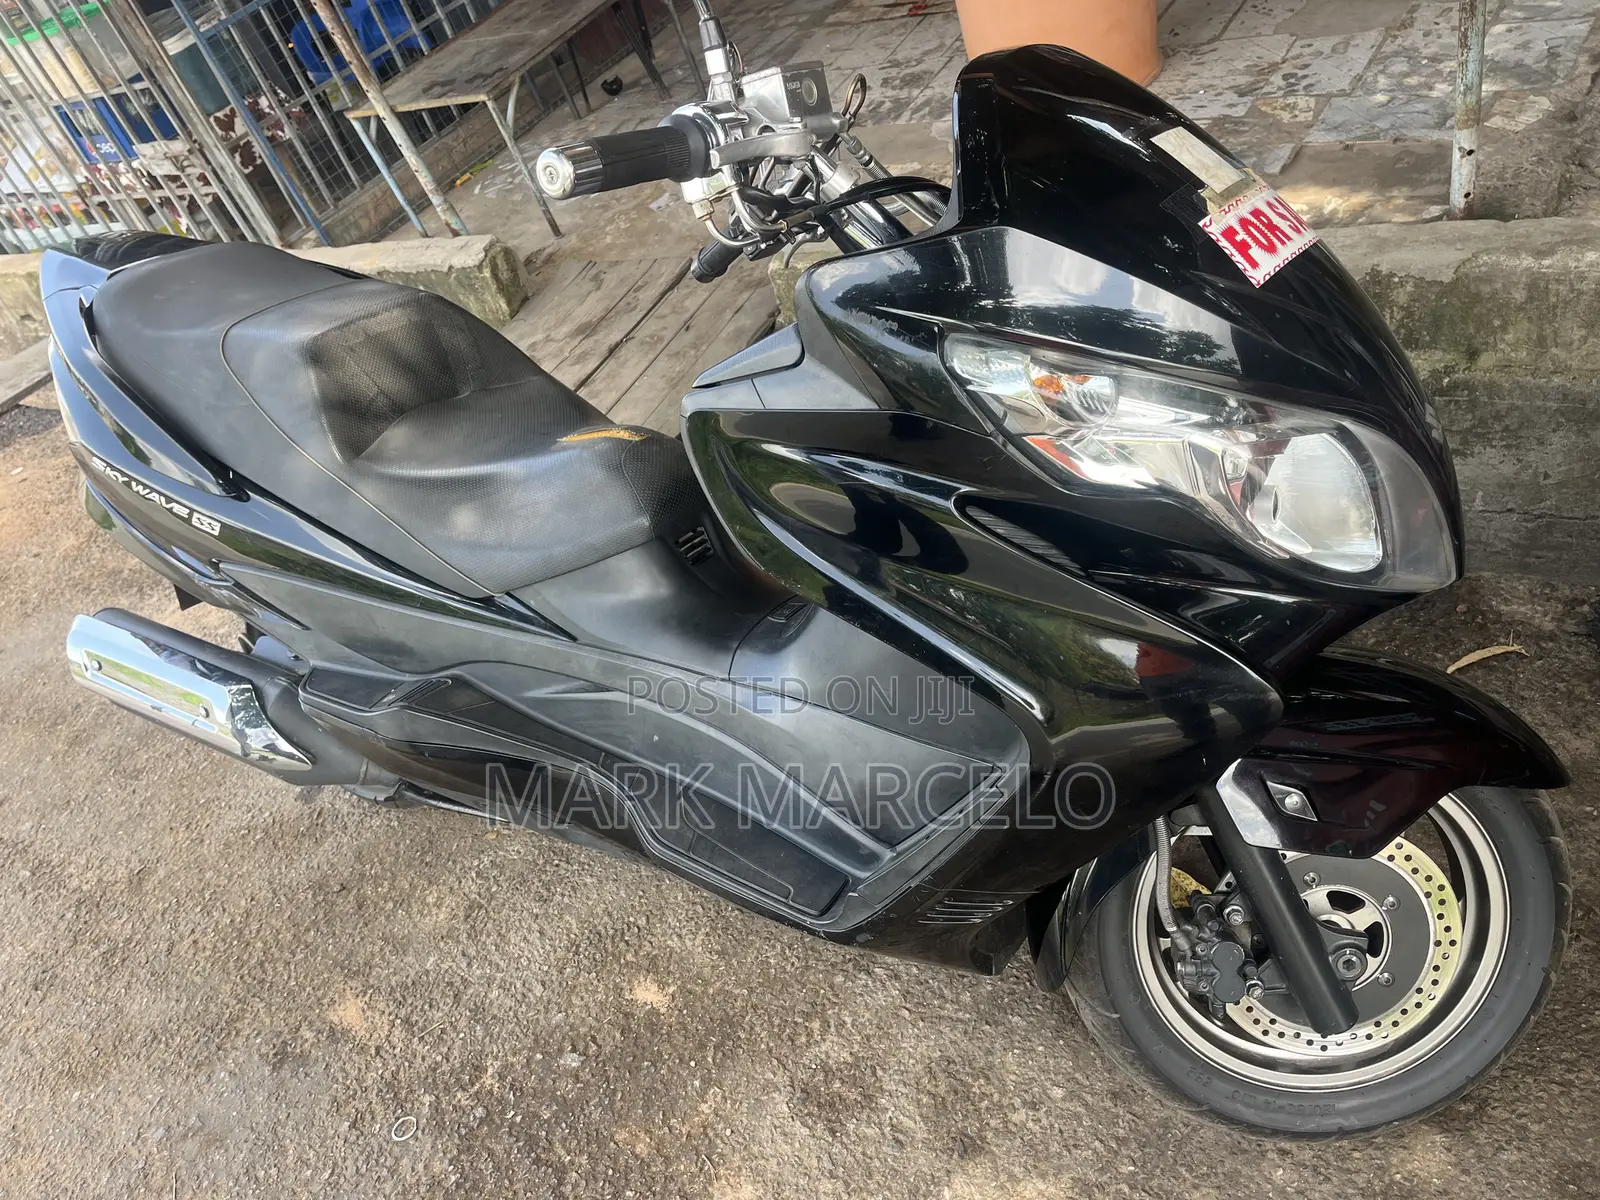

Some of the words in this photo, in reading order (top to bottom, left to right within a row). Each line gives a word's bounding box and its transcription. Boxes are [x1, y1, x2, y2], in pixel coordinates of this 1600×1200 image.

[1218, 206, 1293, 270] FOR
[91, 456, 129, 483] SKY
[131, 481, 190, 519] WAVE
